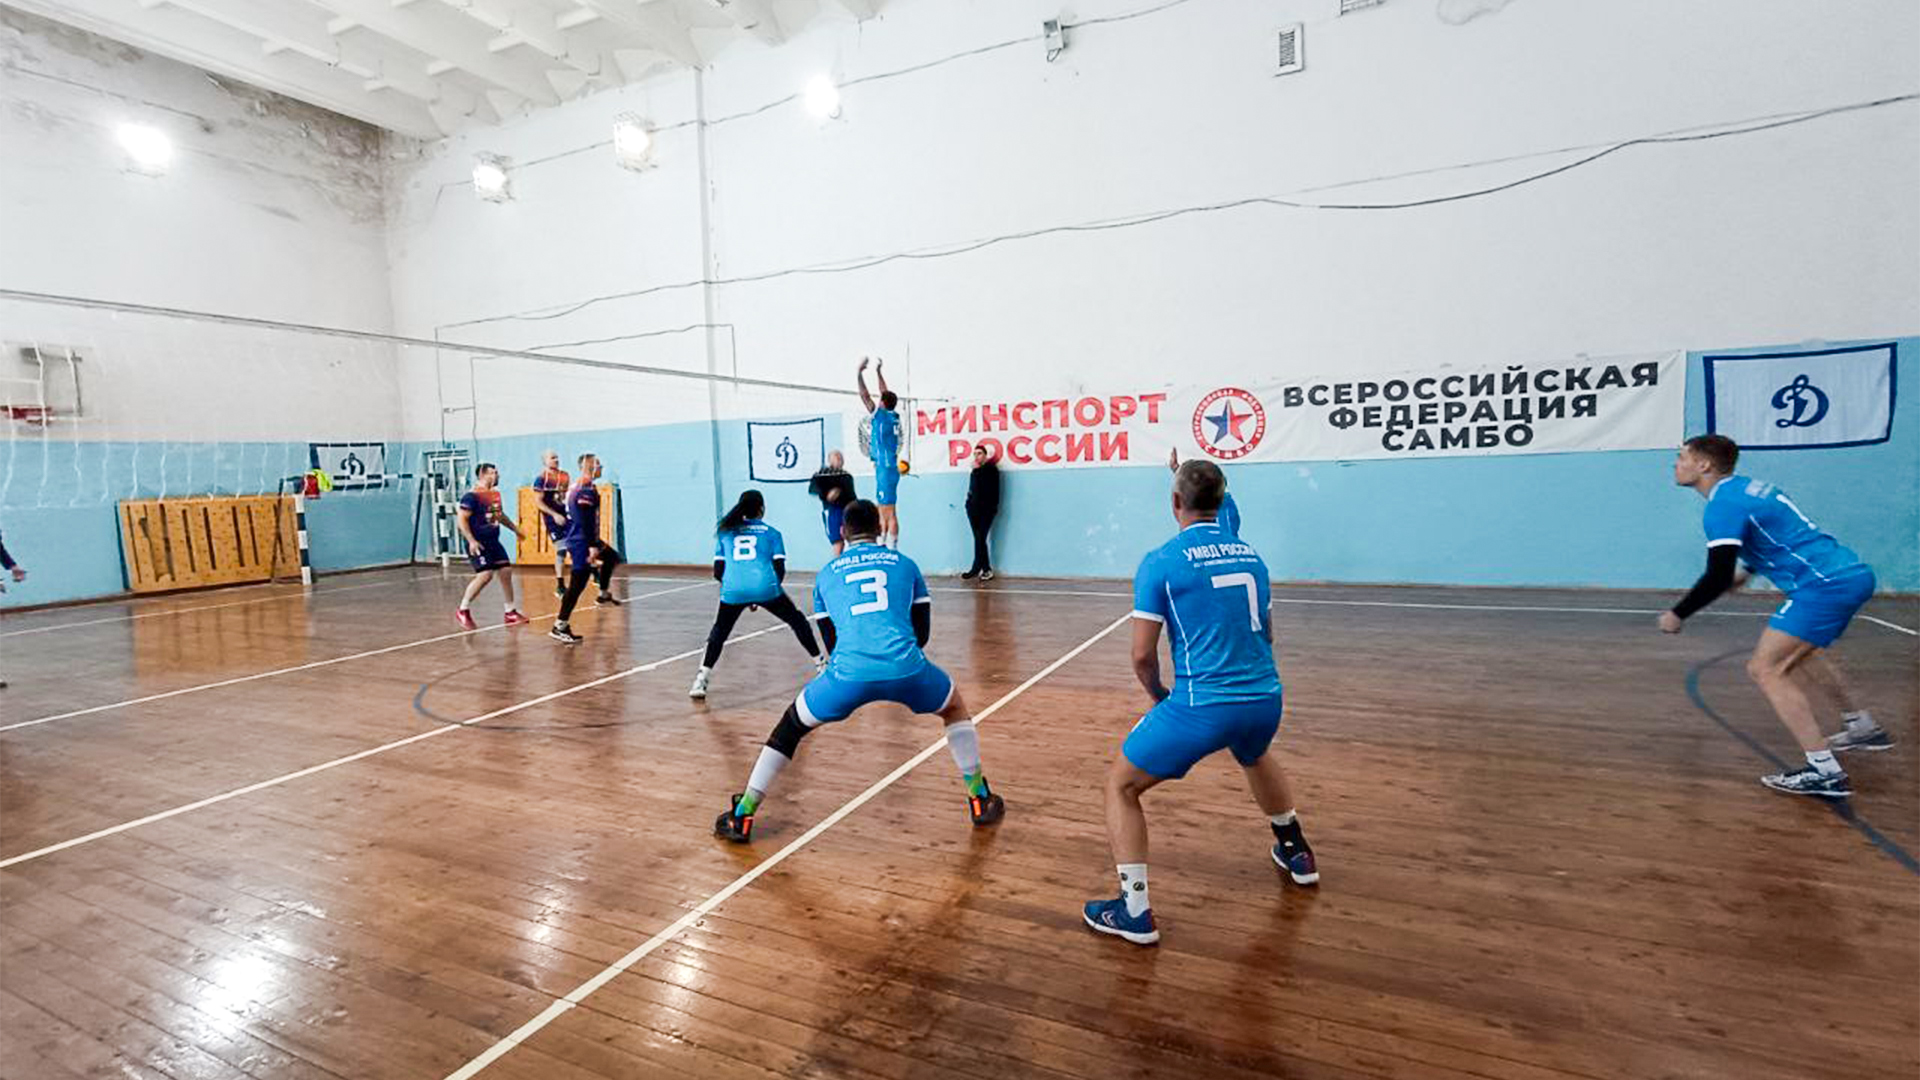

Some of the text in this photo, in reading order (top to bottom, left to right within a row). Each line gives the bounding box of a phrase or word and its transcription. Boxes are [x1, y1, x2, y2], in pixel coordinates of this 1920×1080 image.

[1284, 361, 1659, 407] ВСЕРОССИЙСКАЯ
[917, 393, 1166, 436] МИНСПОРТ
[1328, 394, 1598, 430] ФЕДЕРАЦИЯ
[949, 431, 1128, 467] РОССИИ
[1382, 423, 1534, 451] САМБО
[733, 535, 757, 561] 8
[1182, 543, 1256, 561] УМВД РОССИ
[845, 570, 888, 616] 3
[1211, 572, 1262, 632] 7
